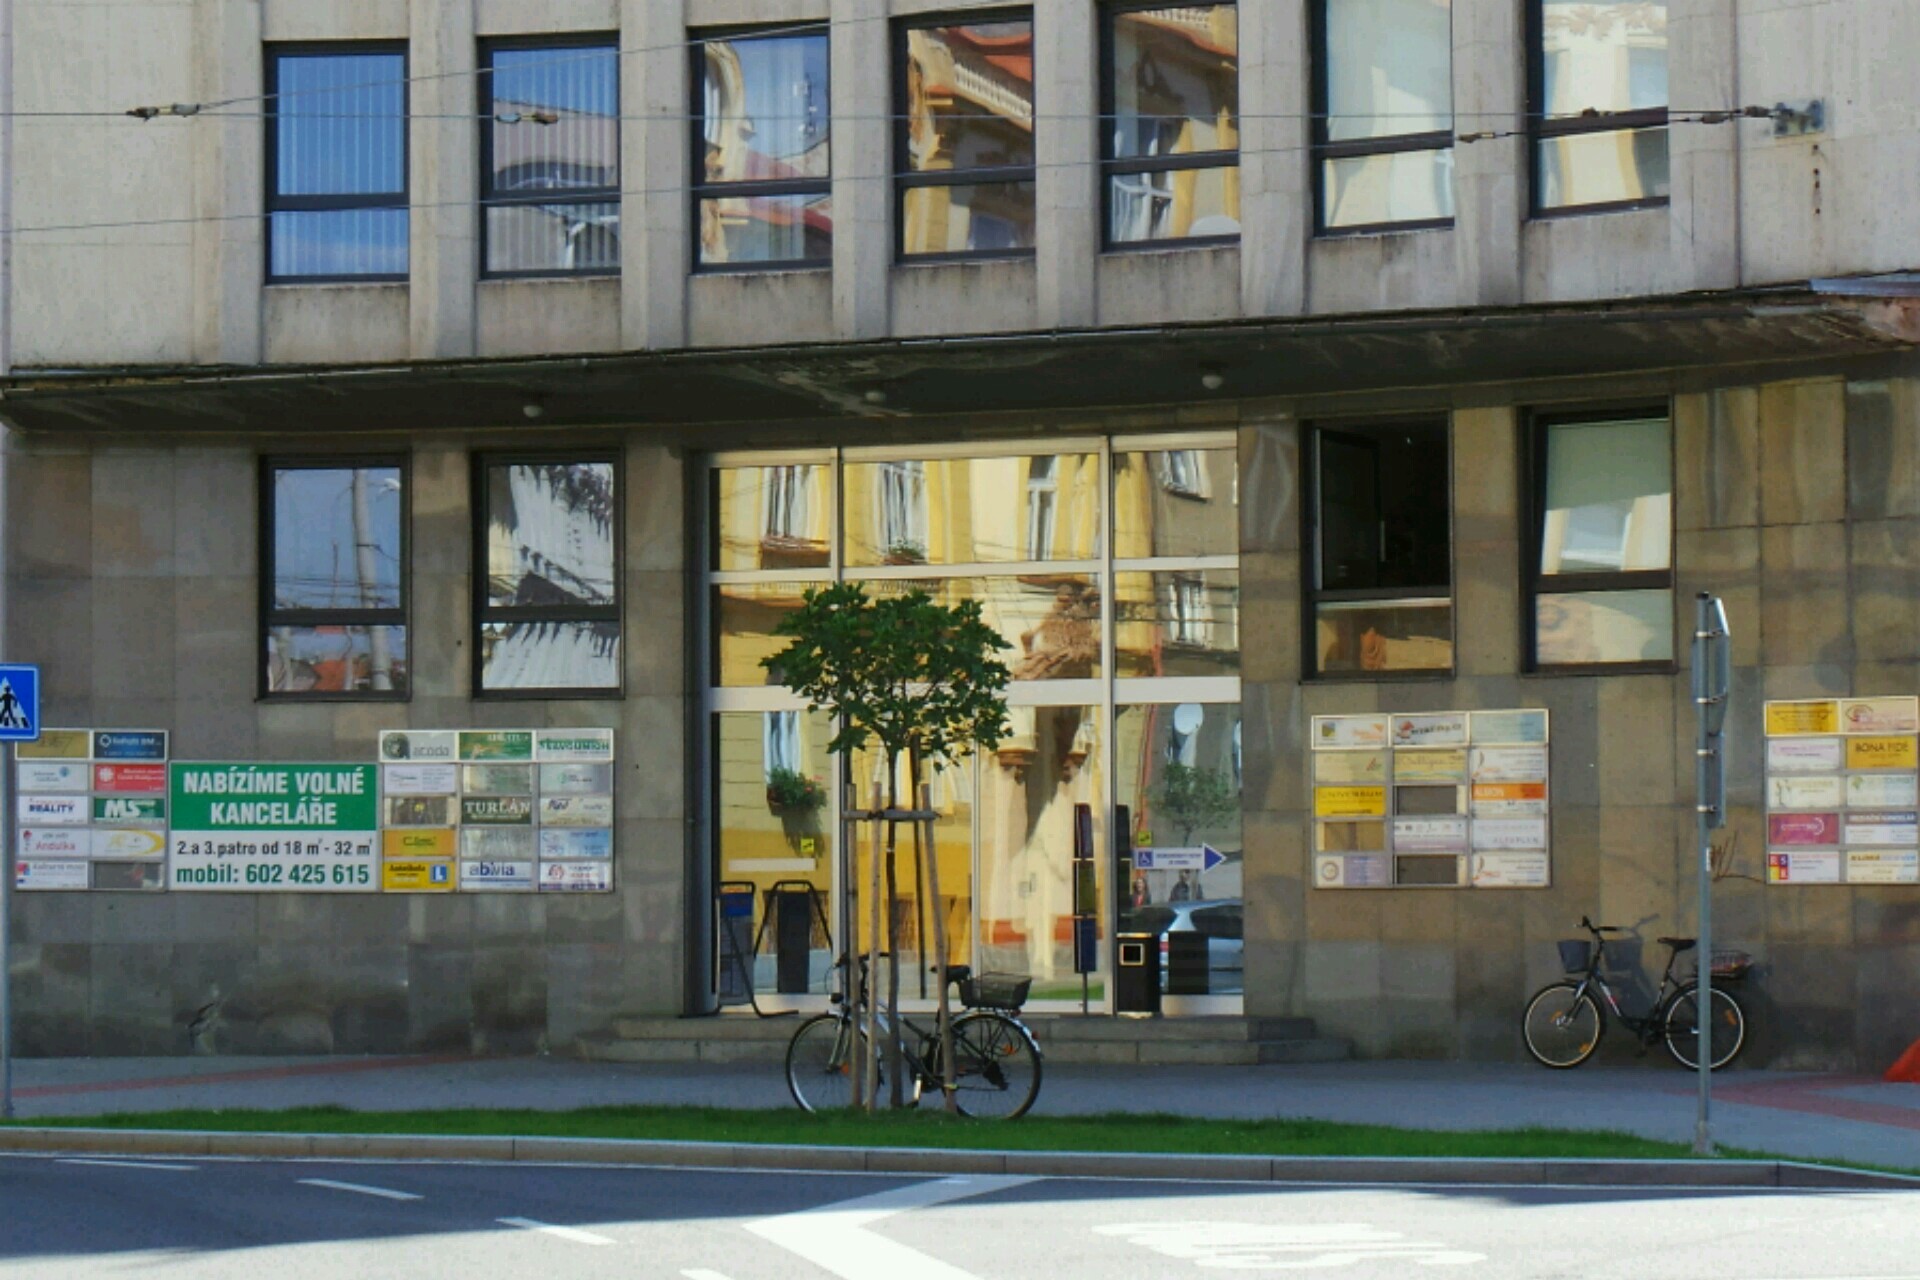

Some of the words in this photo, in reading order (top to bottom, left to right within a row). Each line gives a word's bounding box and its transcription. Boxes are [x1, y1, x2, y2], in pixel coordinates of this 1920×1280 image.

[183, 766, 288, 794] NABÍZÍME
[295, 766, 365, 794] VOLNÉ
[210, 796, 337, 825] KANCELÁŘE
[261, 841, 279, 855] od
[285, 841, 302, 855] 18
[334, 841, 352, 855] 32
[176, 864, 239, 883] mobil:
[245, 864, 283, 884] 602
[288, 864, 326, 884] 425
[332, 864, 370, 884] 615
